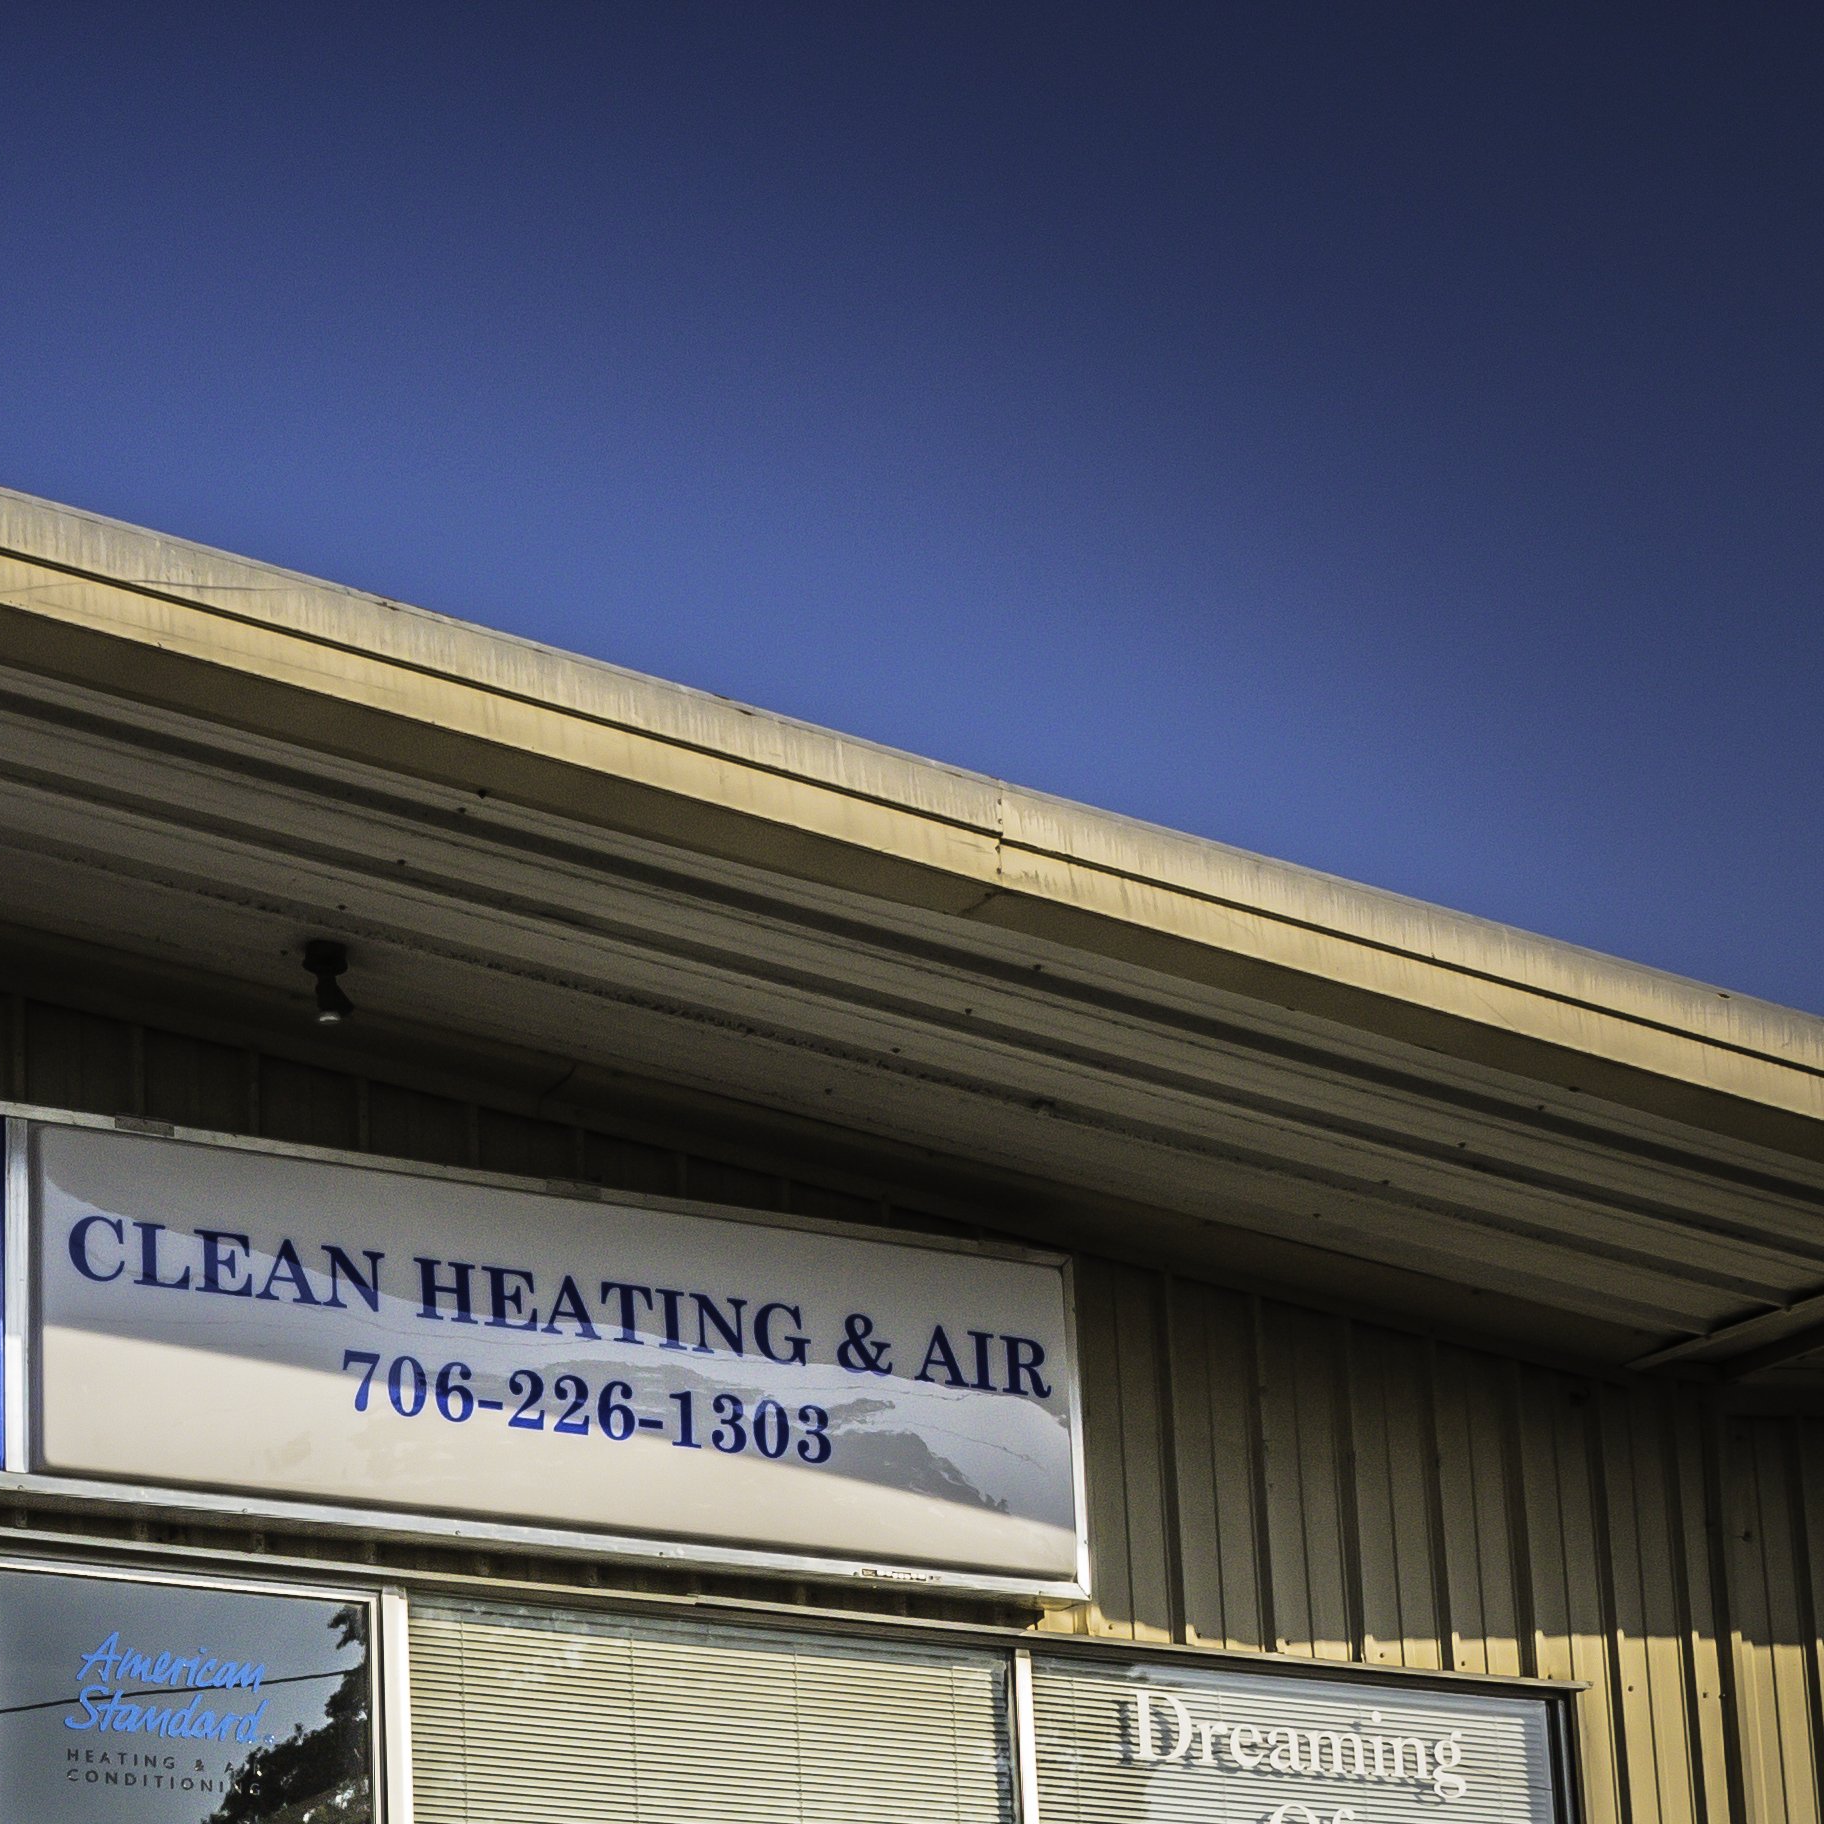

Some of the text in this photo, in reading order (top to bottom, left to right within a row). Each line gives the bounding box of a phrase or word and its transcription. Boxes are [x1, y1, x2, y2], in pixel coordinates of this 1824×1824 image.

[67, 1214, 1051, 1399] CLEAN HEATING & AIR
[342, 1349, 831, 1464] 706-226-1303
[76, 1631, 265, 1693] American
[65, 1684, 269, 1743] Standard
[1133, 1688, 1467, 1799] Dreaming
[67, 1748, 176, 1770] HEATING
[195, 1759, 204, 1772] &
[67, 1769, 261, 1796] CONDITIONING
